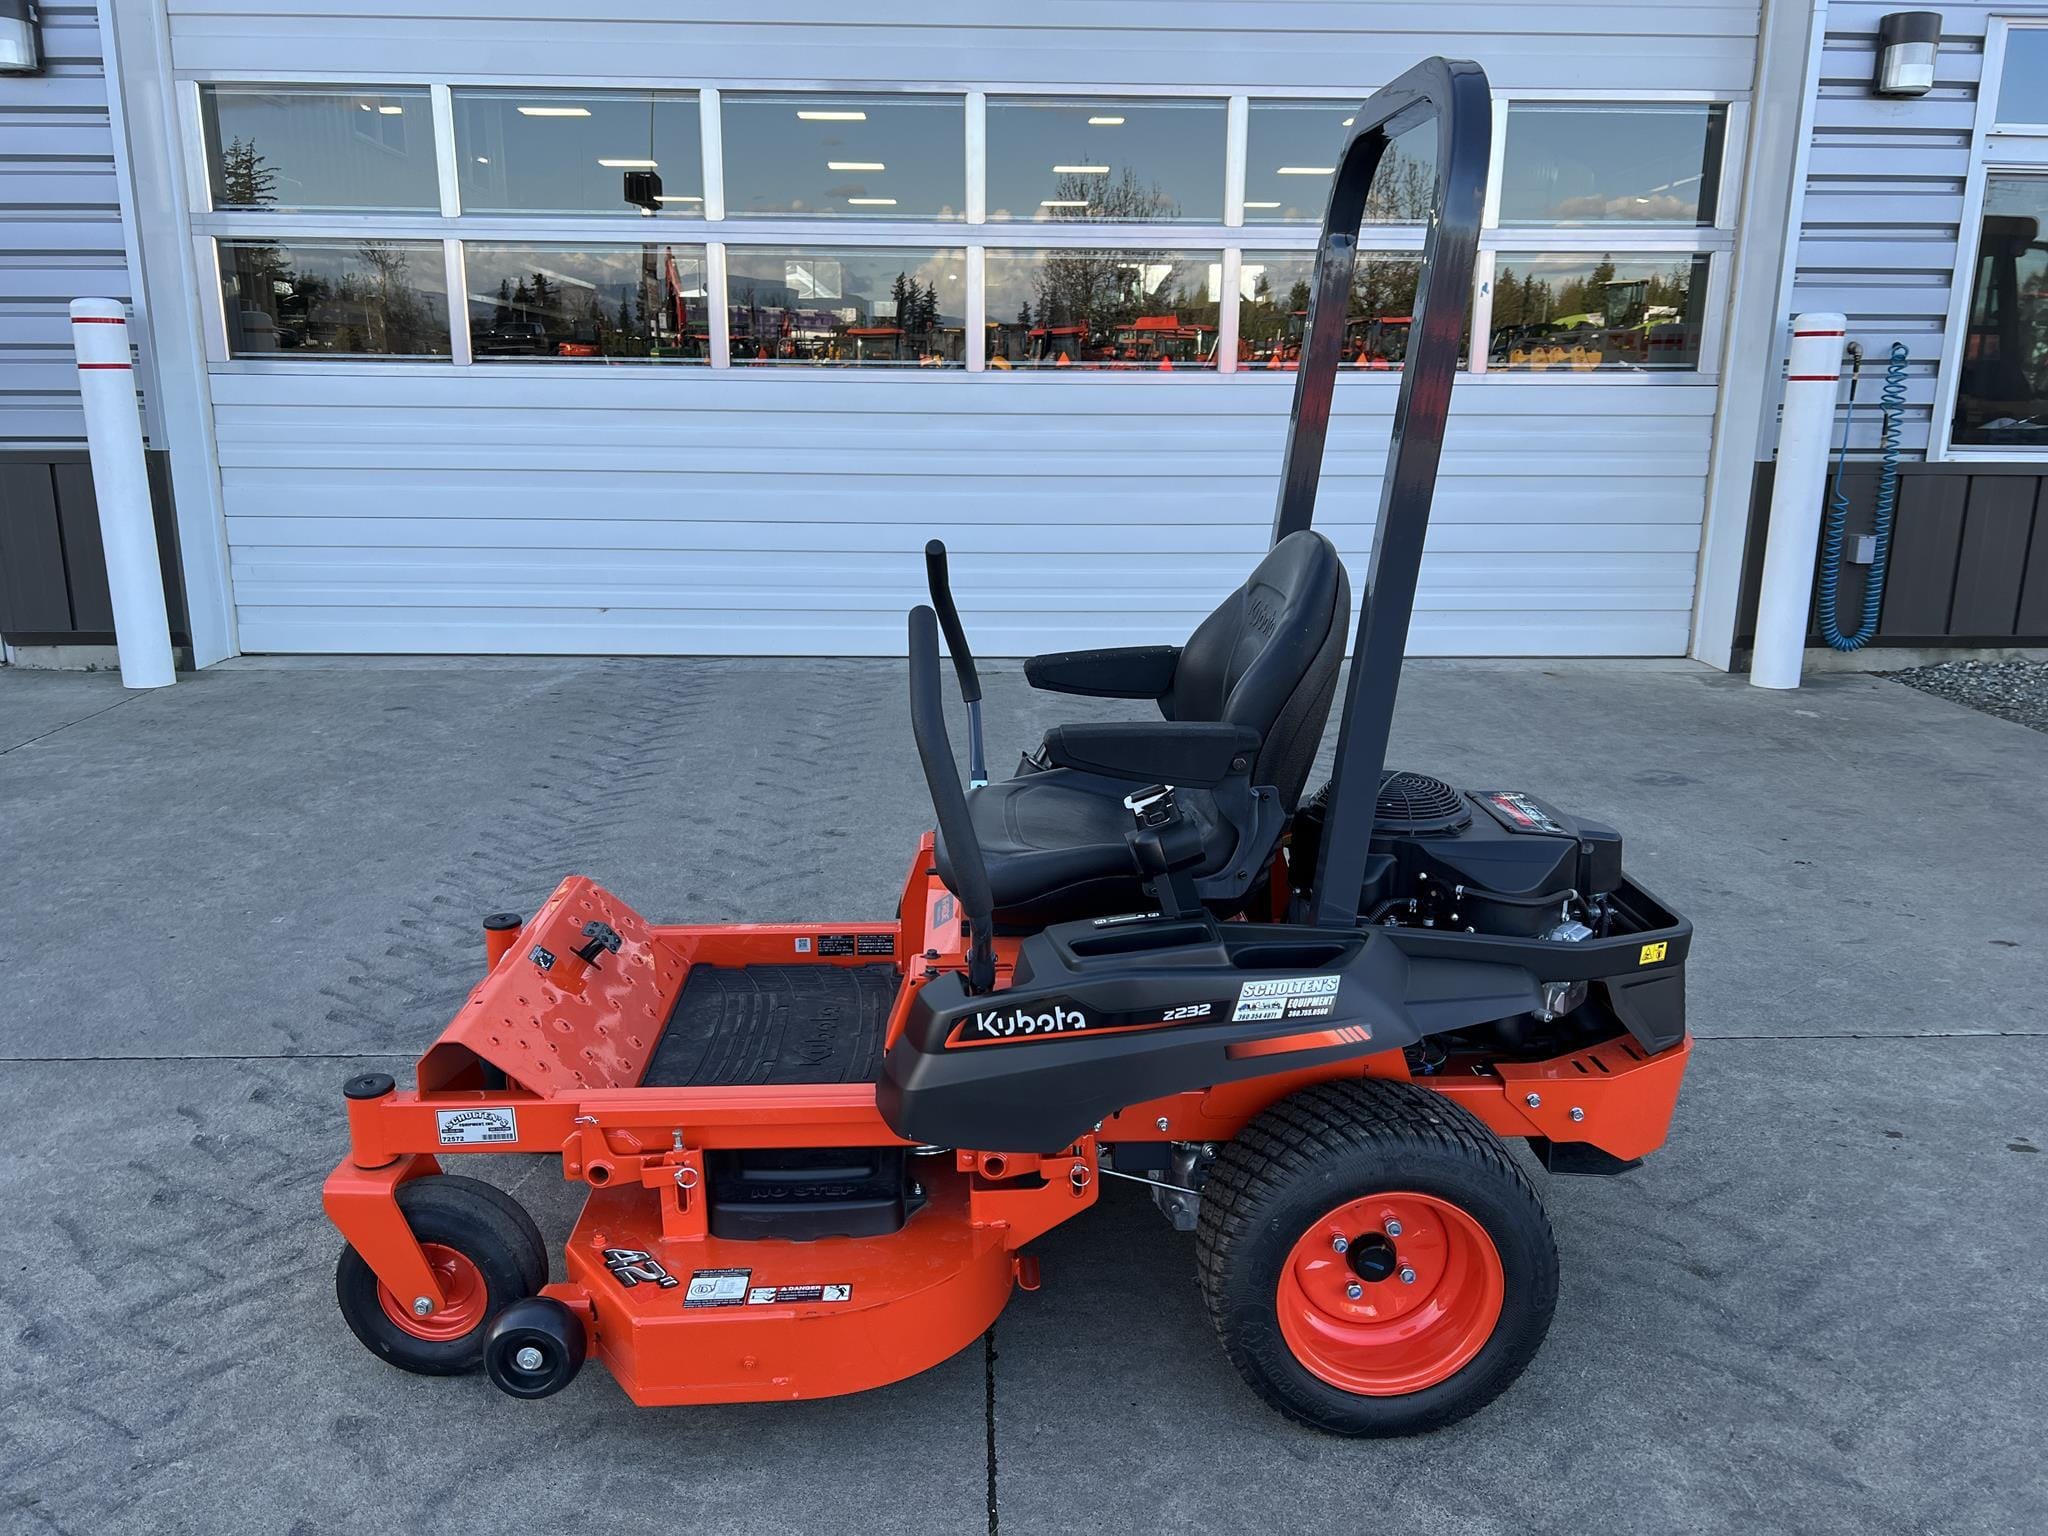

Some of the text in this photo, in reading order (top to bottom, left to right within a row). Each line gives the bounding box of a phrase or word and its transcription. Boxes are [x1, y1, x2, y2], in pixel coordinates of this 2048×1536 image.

[1242, 978, 1337, 998] SCHOLTEN'S
[1286, 995, 1335, 1009] EQUIPMENT
[976, 1006, 1086, 1036] Kubota
